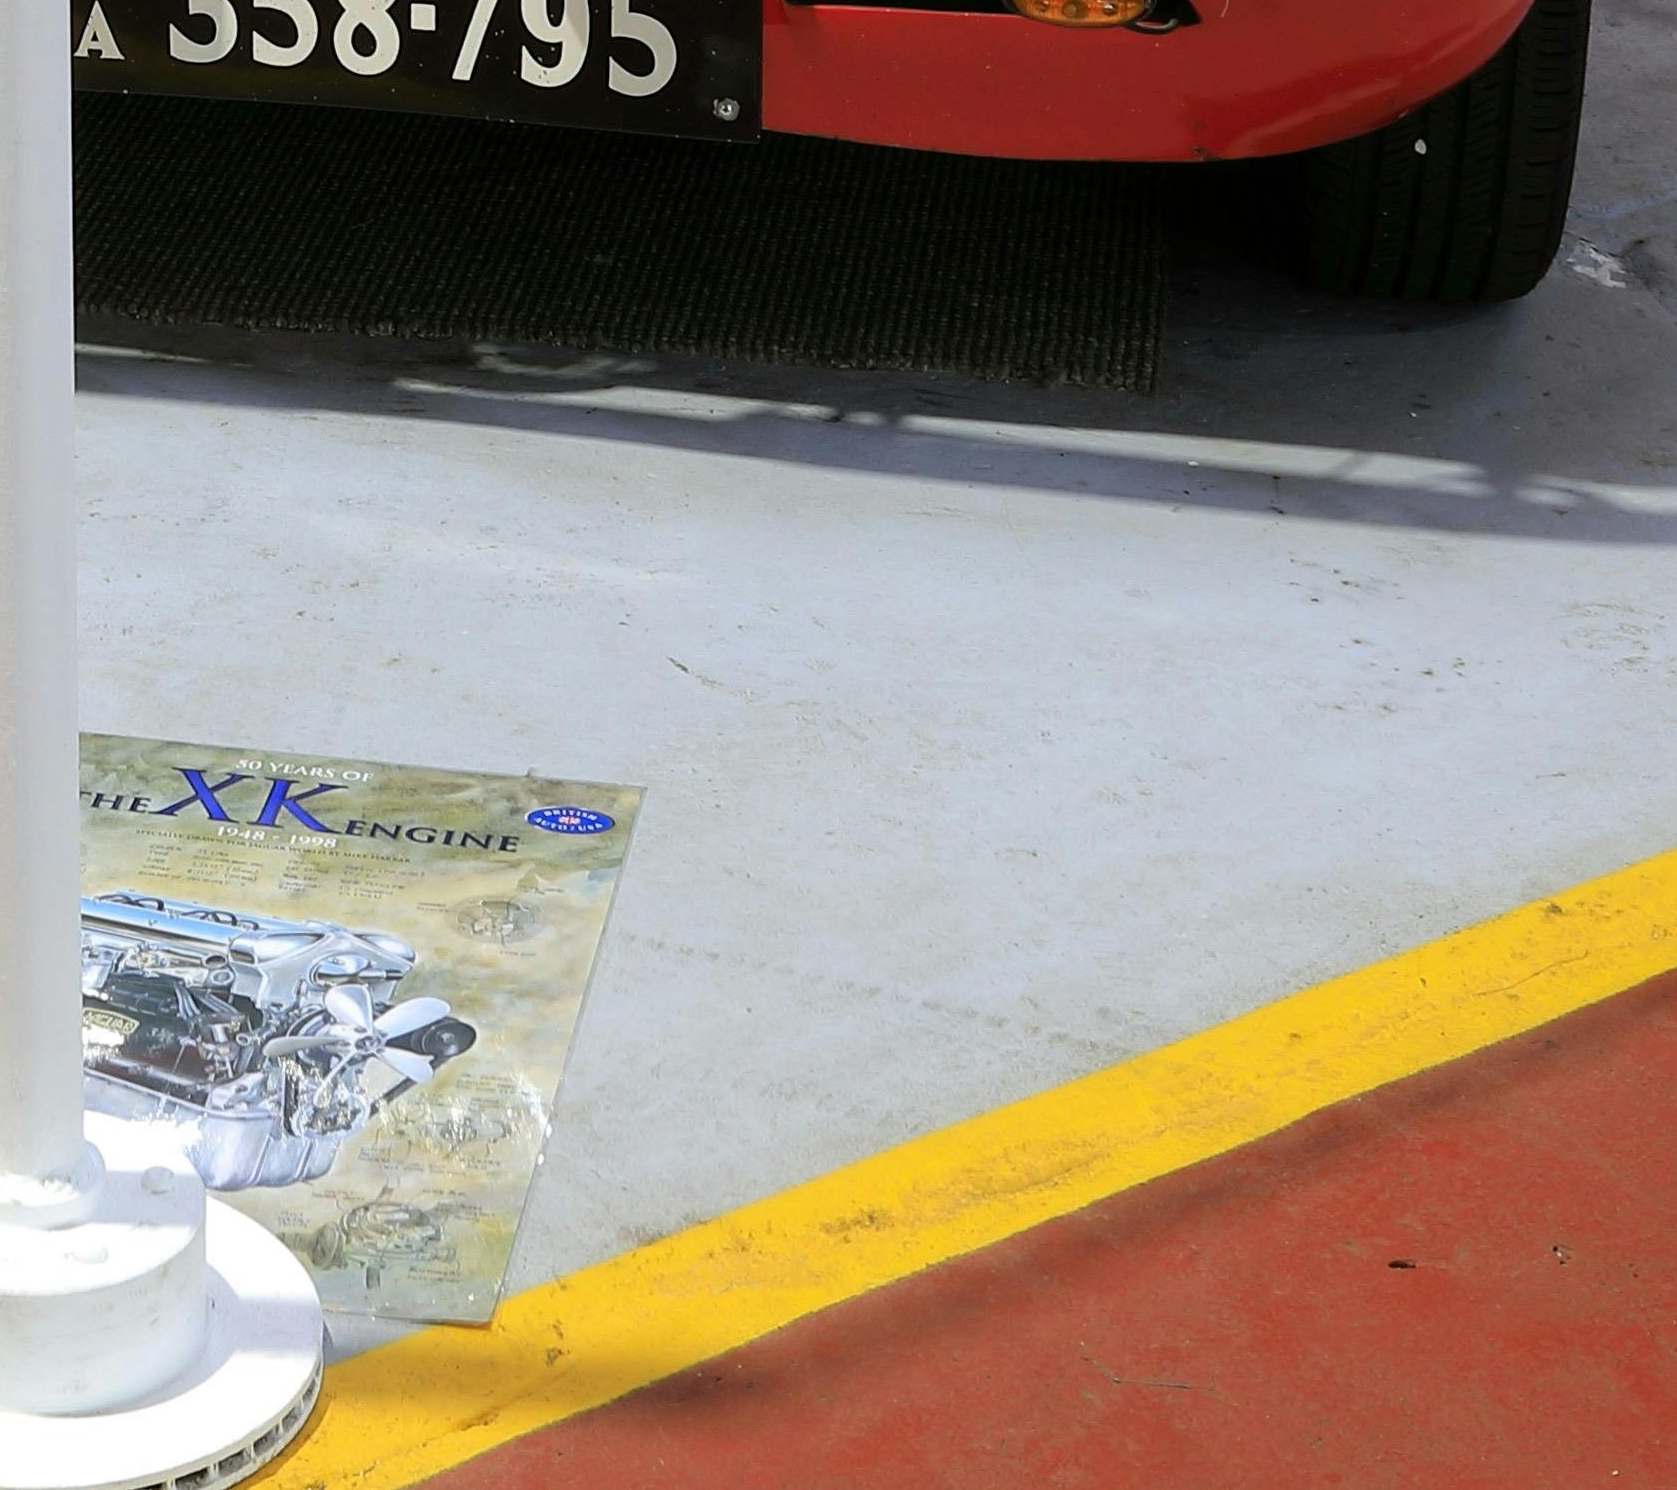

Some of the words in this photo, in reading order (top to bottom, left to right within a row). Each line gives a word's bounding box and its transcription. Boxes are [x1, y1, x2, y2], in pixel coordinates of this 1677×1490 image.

[73, 1, 123, 61] A
[235, 759, 262, 771] 50
[269, 762, 336, 779] YEARS
[342, 770, 375, 783] OF
[147, 767, 349, 835] XK
[347, 819, 520, 853] ENGINE
[543, 808, 598, 821] BRITISH
[217, 825, 265, 841] 1948
[289, 834, 337, 849] 1998
